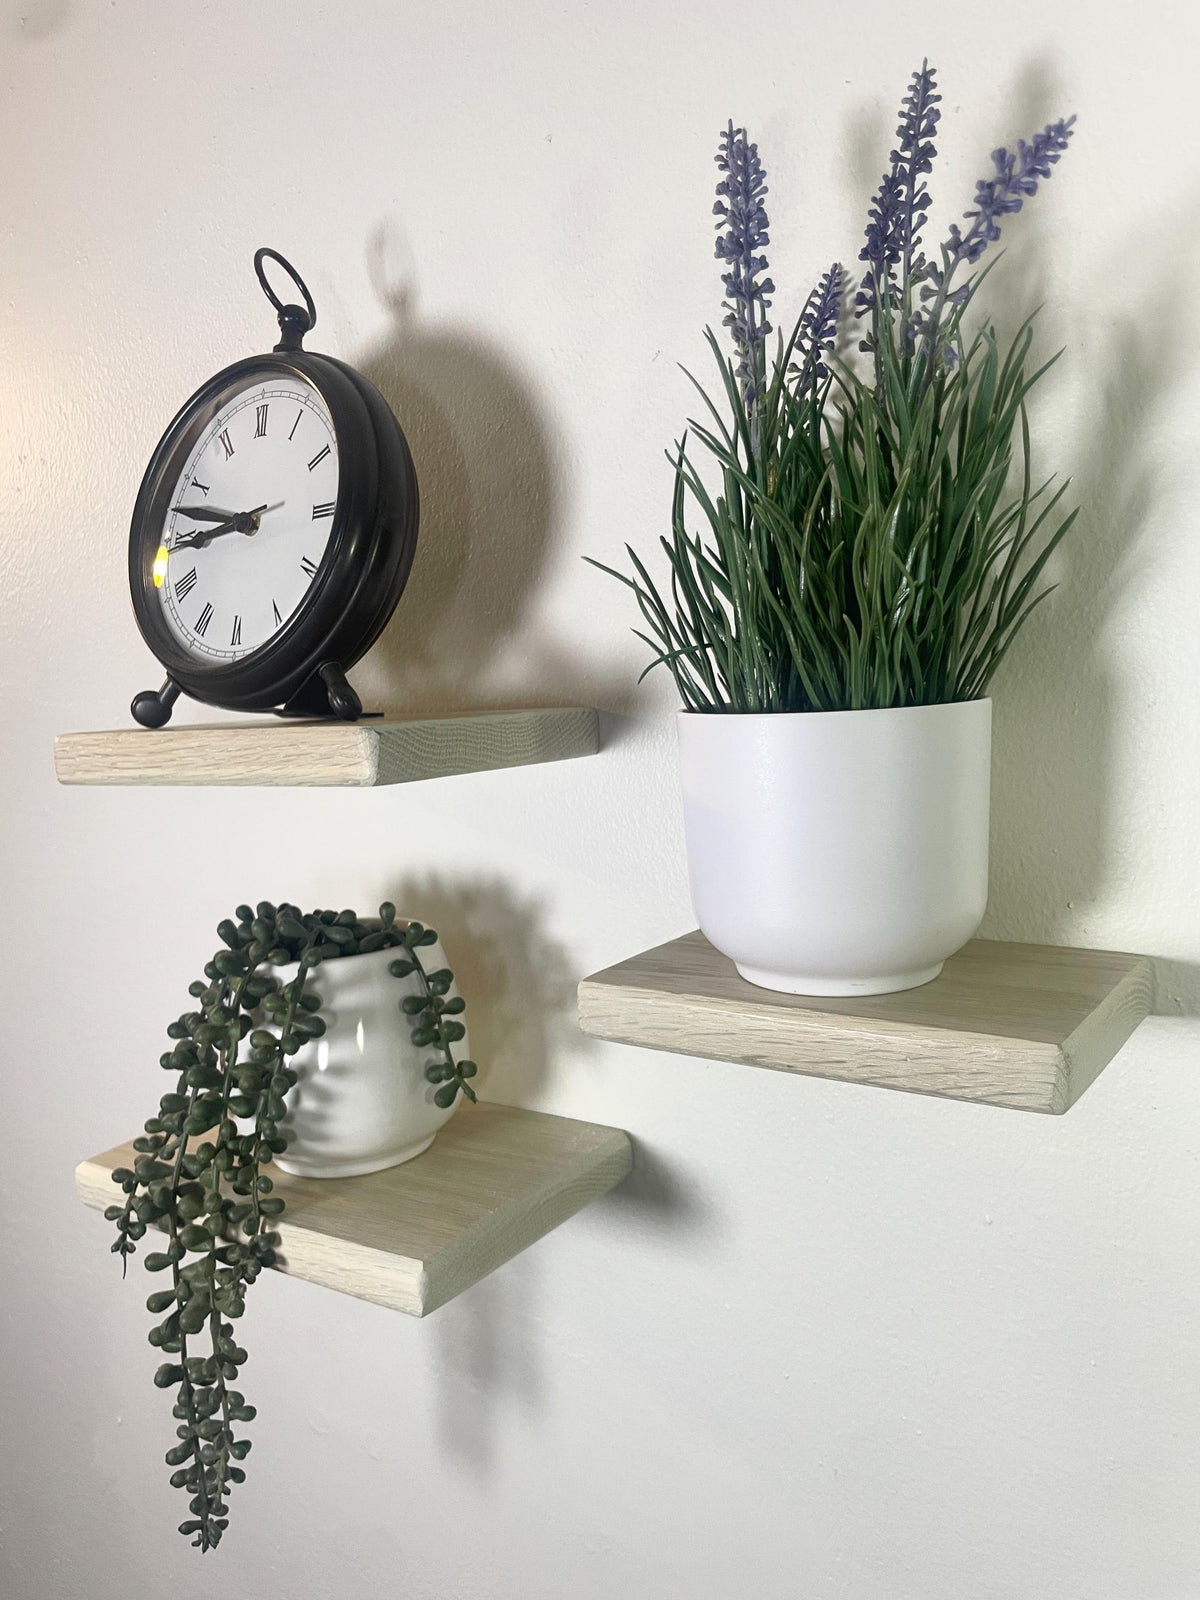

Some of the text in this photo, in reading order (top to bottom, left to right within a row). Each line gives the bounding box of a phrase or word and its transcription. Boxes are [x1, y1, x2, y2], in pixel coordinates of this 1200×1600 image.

[253, 404, 269, 439] XII
[288, 409, 303, 441] I
[219, 427, 235, 461] XI
[308, 443, 331, 472] II
[191, 476, 210, 496] X
[312, 500, 336, 521] III
[174, 566, 197, 604] VIII
[194, 602, 215, 637] VII
[230, 615, 242, 646] VI
